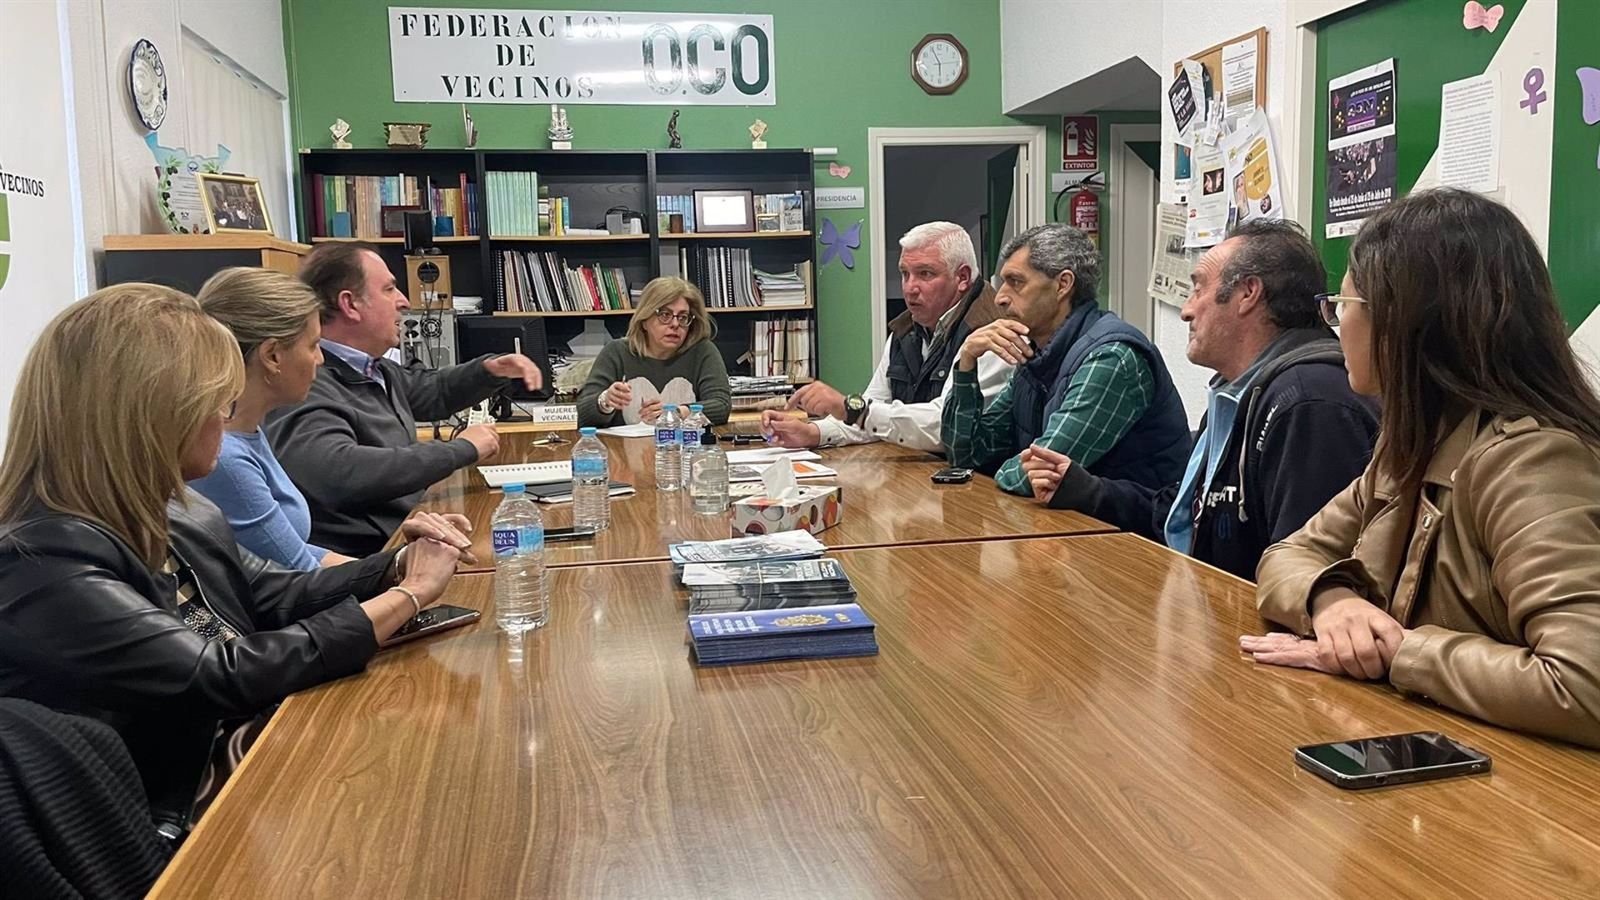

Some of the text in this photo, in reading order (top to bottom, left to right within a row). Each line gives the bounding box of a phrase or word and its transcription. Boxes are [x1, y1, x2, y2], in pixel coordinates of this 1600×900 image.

[400, 14, 622, 38] FEDERACION
[495, 43, 537, 67] DE
[440, 75, 594, 99] VECINOS
[0, 172, 45, 198] VECINOS
